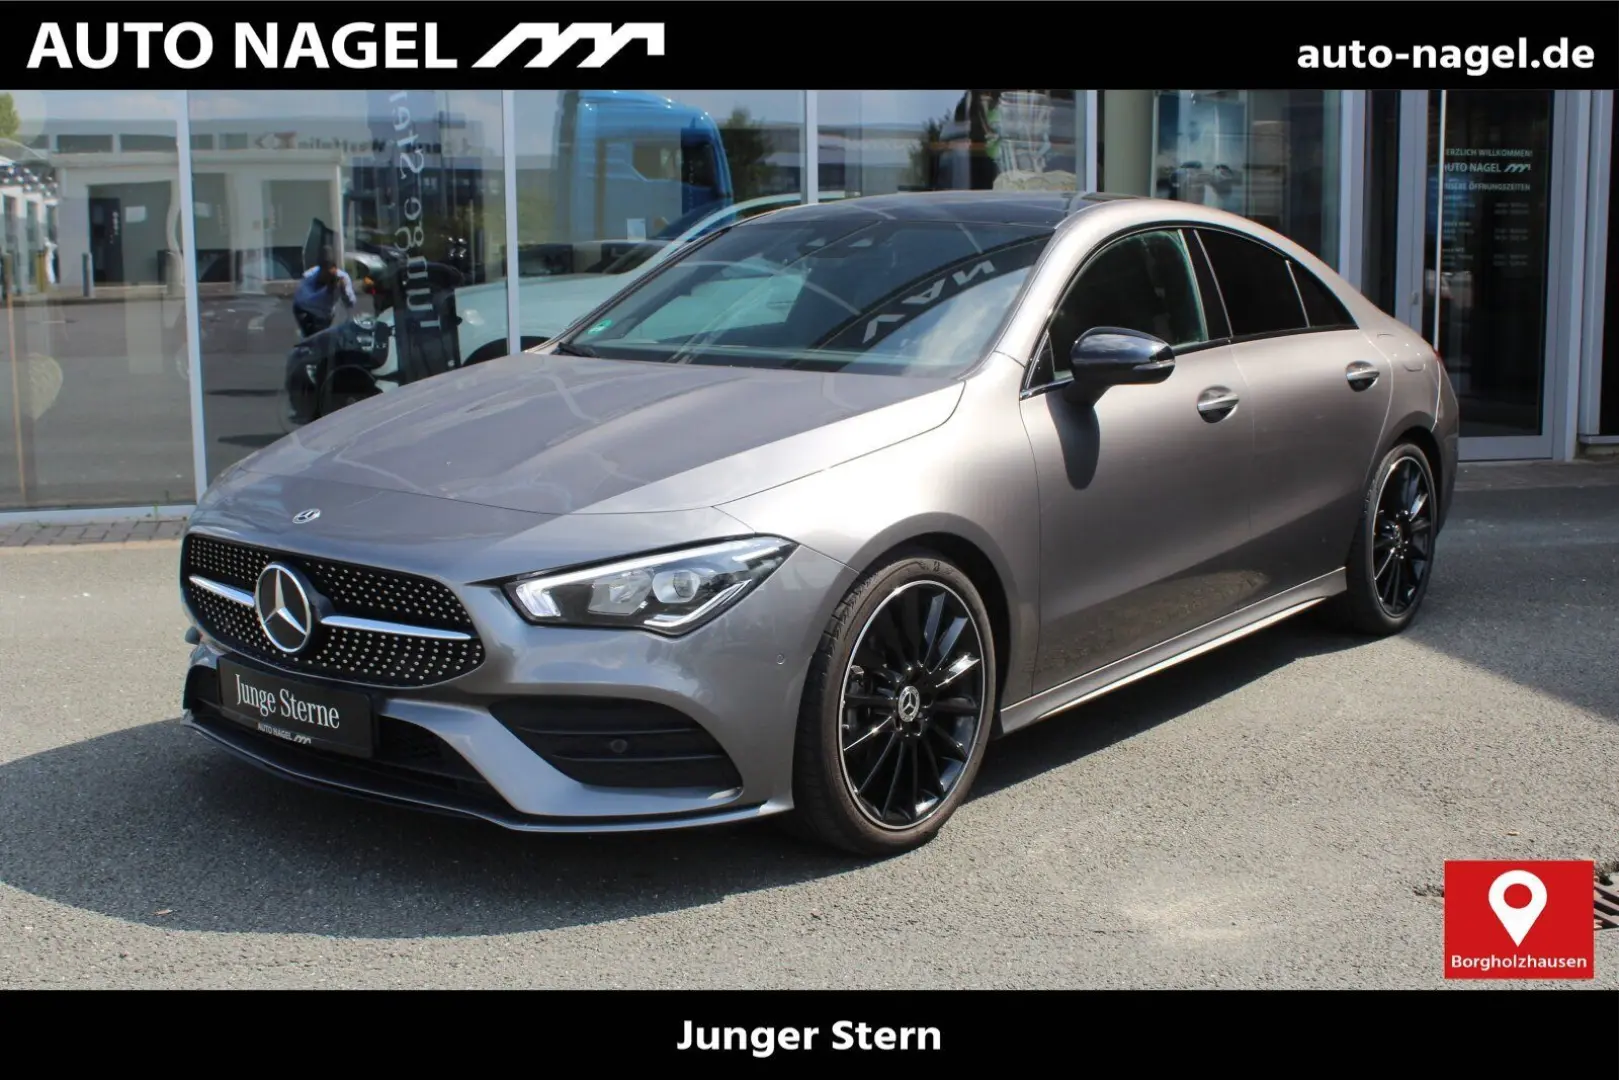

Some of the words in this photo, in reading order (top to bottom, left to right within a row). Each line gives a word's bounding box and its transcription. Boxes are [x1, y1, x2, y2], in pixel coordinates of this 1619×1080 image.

[1445, 148, 1477, 157] ERZLICH
[1469, 162, 1502, 173] NAGEL
[235, 673, 277, 717] Junge
[279, 688, 340, 729] Sterne
[257, 722, 273, 735] AUTO
[273, 726, 293, 741] NAGEL
